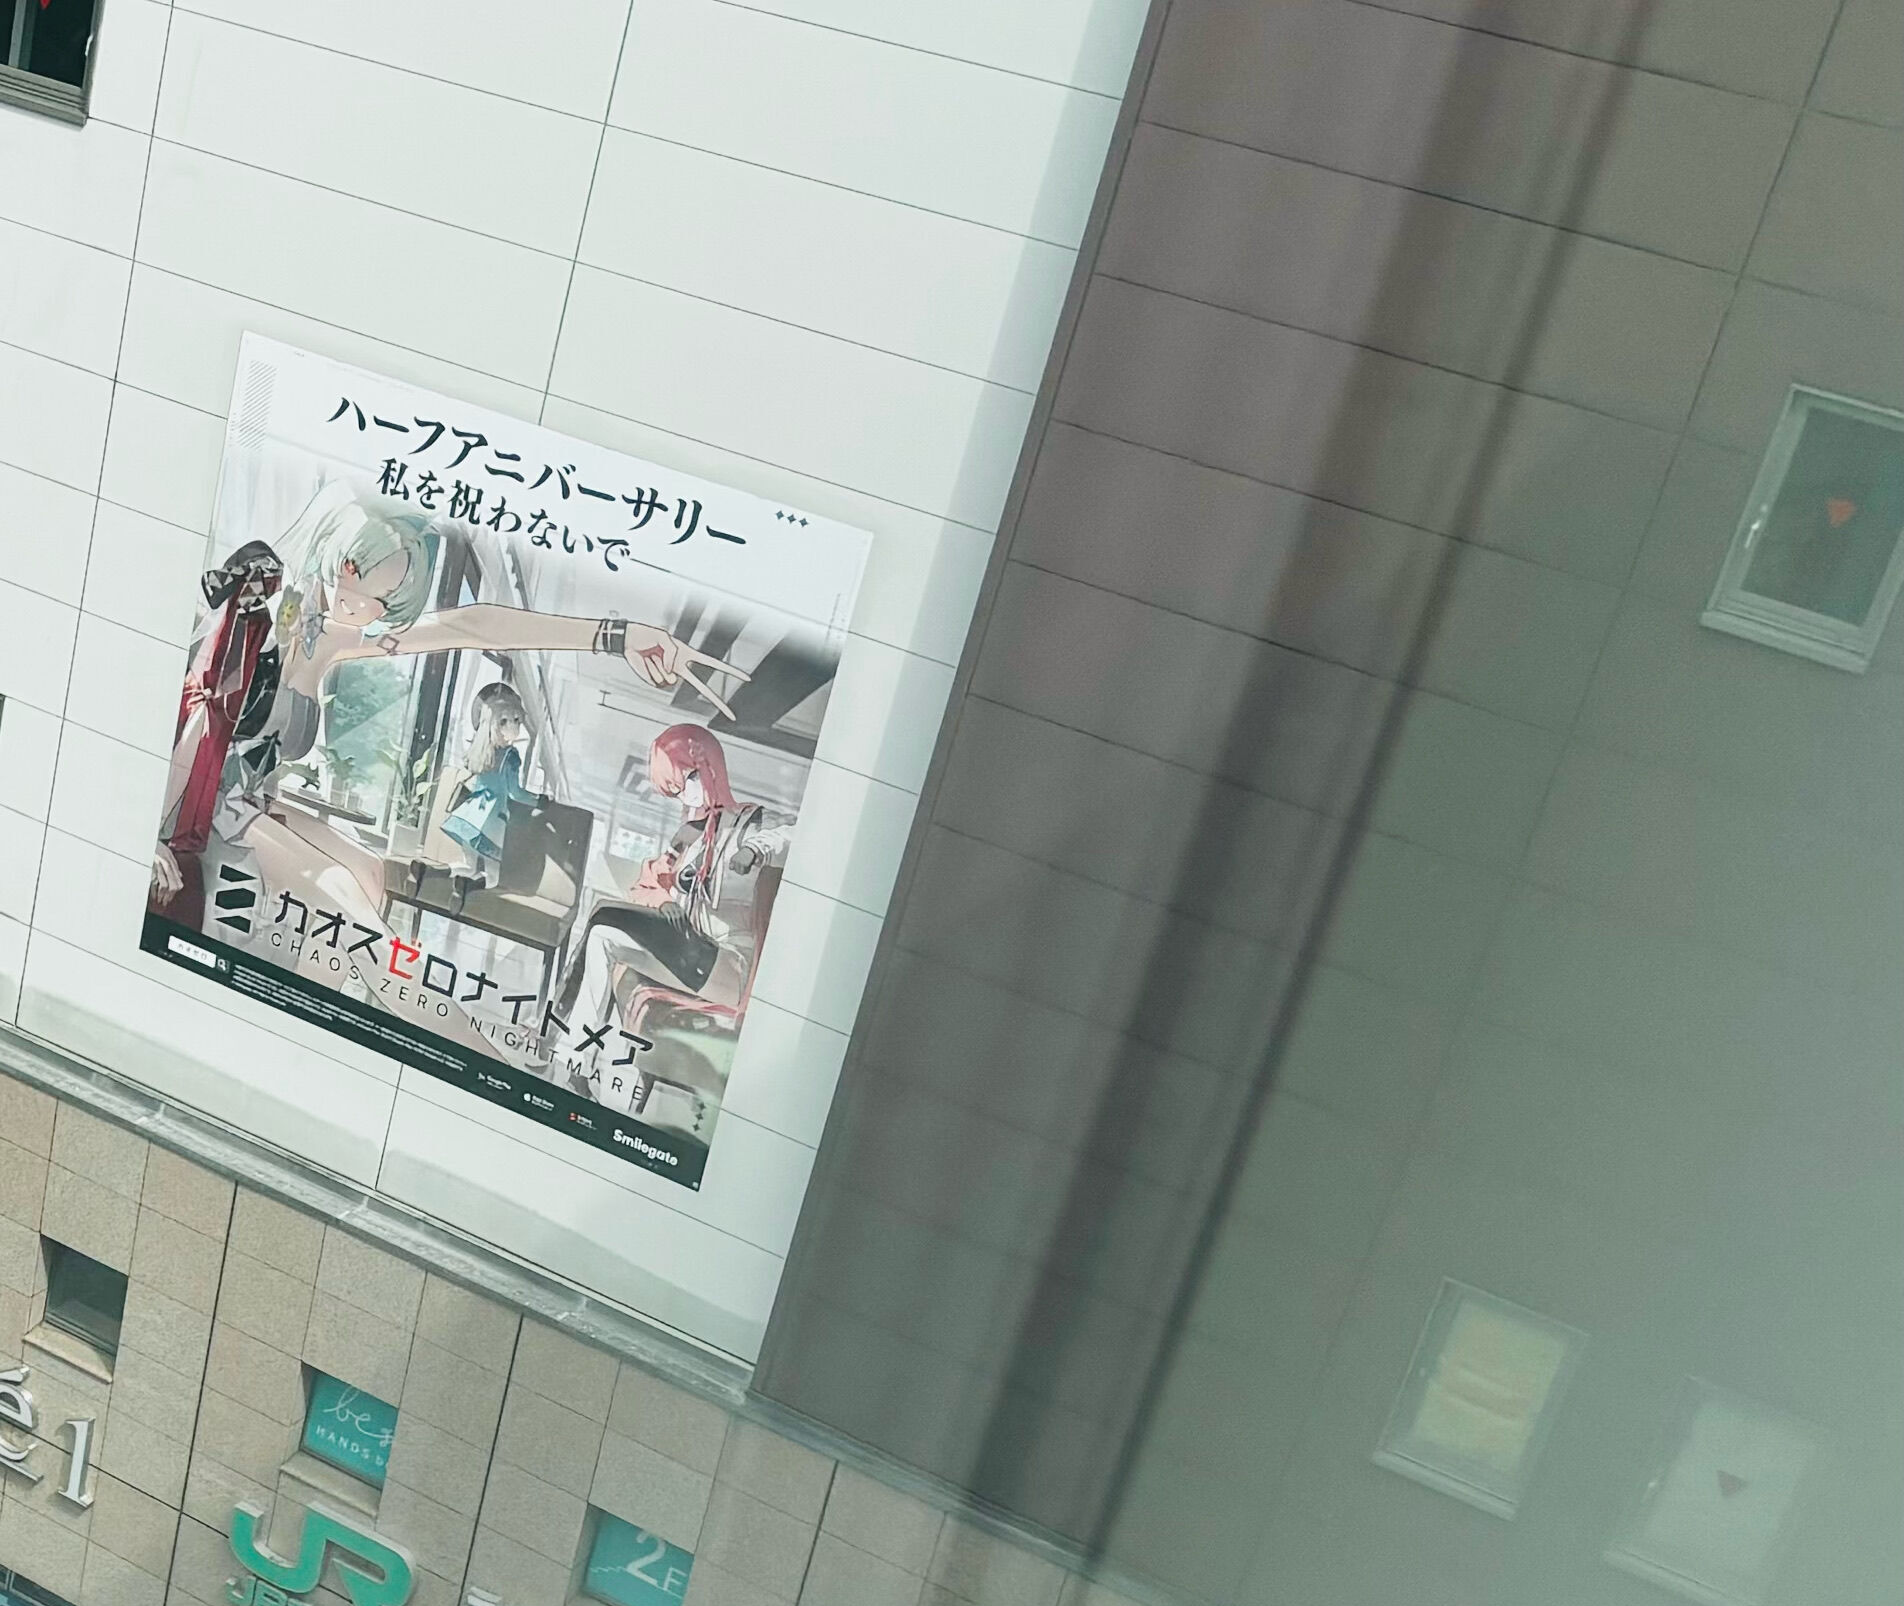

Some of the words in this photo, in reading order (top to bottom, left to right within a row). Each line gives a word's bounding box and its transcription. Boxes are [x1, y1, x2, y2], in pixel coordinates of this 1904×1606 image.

[328, 396, 748, 547] ハーフアニバーサリー
[376, 456, 632, 573] 私を祝わないで
[270, 932, 362, 982] CHAOS
[379, 977, 449, 1018] ZERO
[470, 1015, 646, 1102] NIGHTMARE
[275, 890, 654, 1067] カオスゼロナイトメア
[612, 1128, 679, 1167] Smilegate
[57, 1415, 96, 1510] 1
